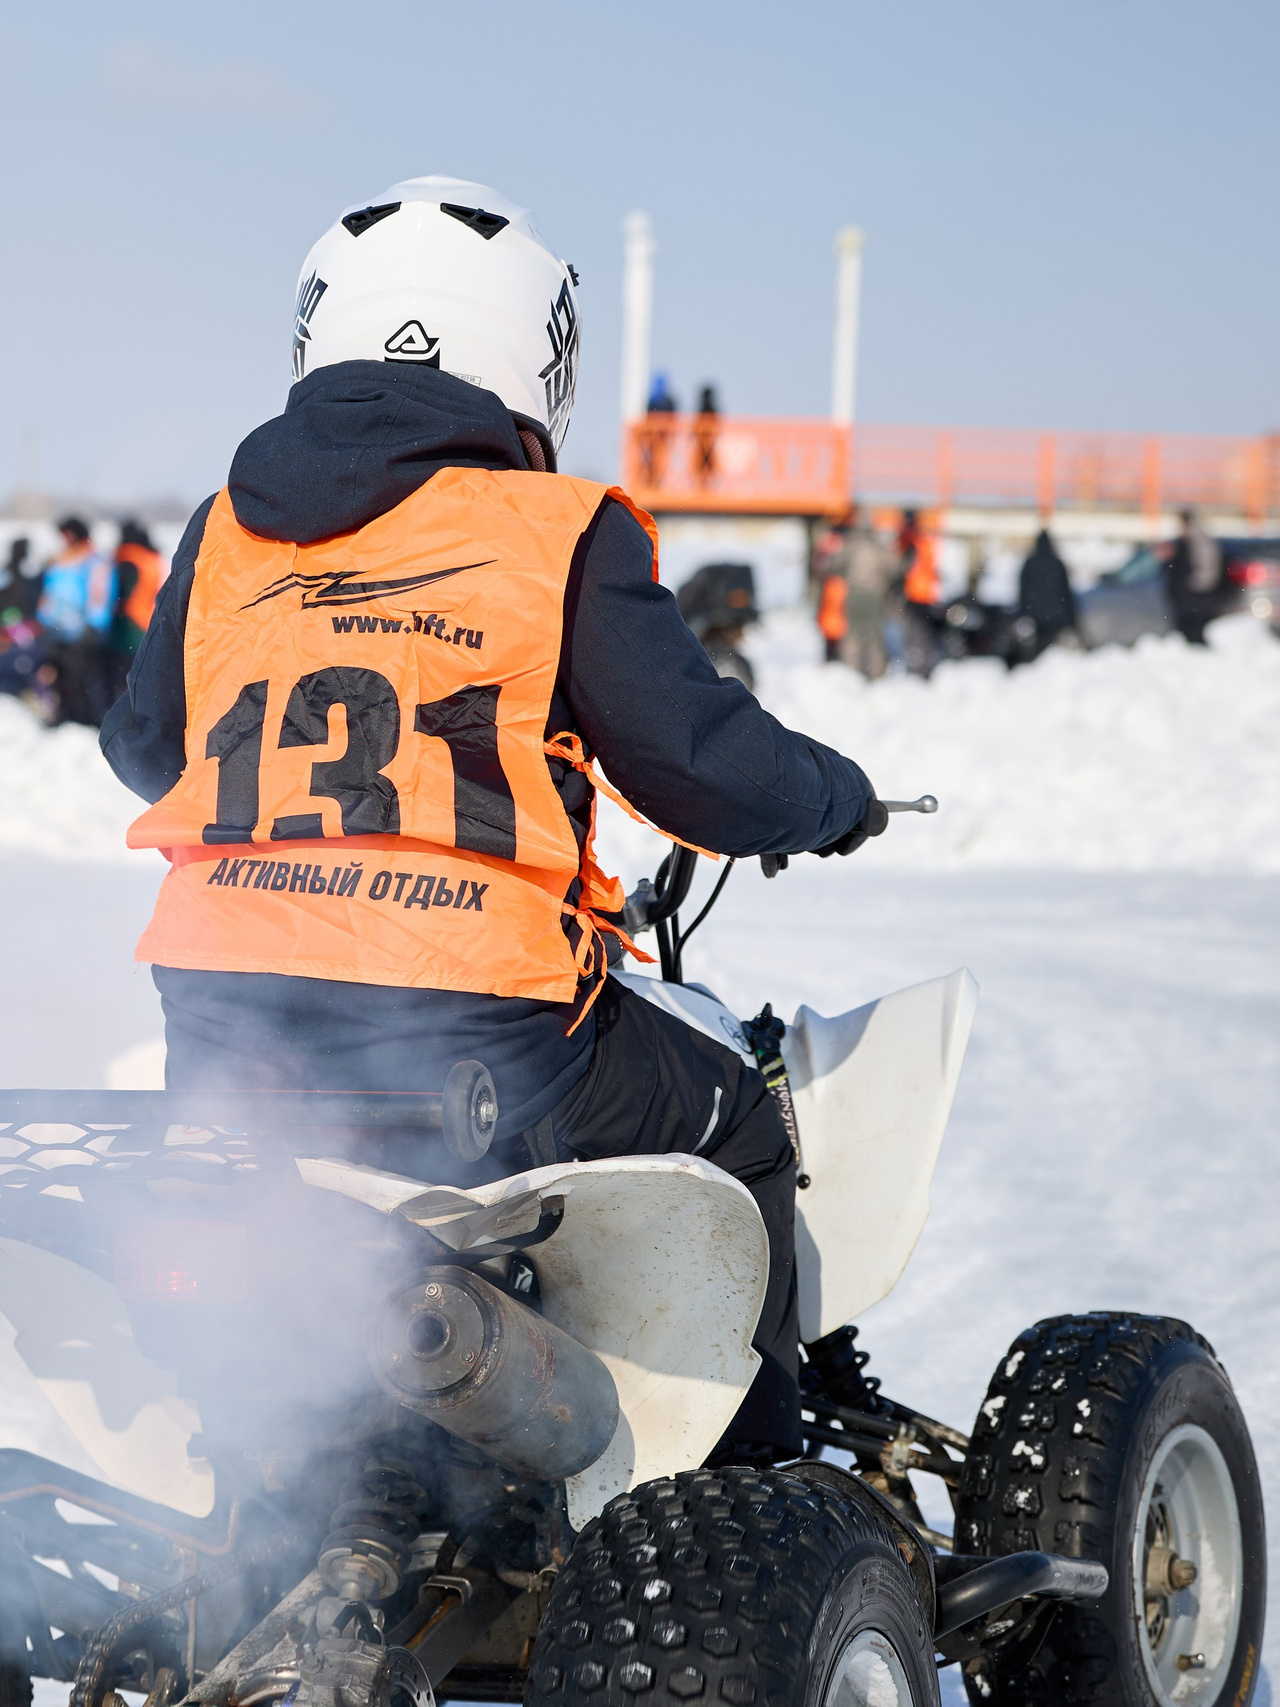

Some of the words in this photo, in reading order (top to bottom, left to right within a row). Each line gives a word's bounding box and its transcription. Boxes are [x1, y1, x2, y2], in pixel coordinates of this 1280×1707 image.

[331, 610, 484, 650] www.hft.ru
[202, 665, 517, 861] 131
[207, 857, 363, 898] АКТИВНЫЙ
[368, 870, 490, 912] ОТДЫХ
